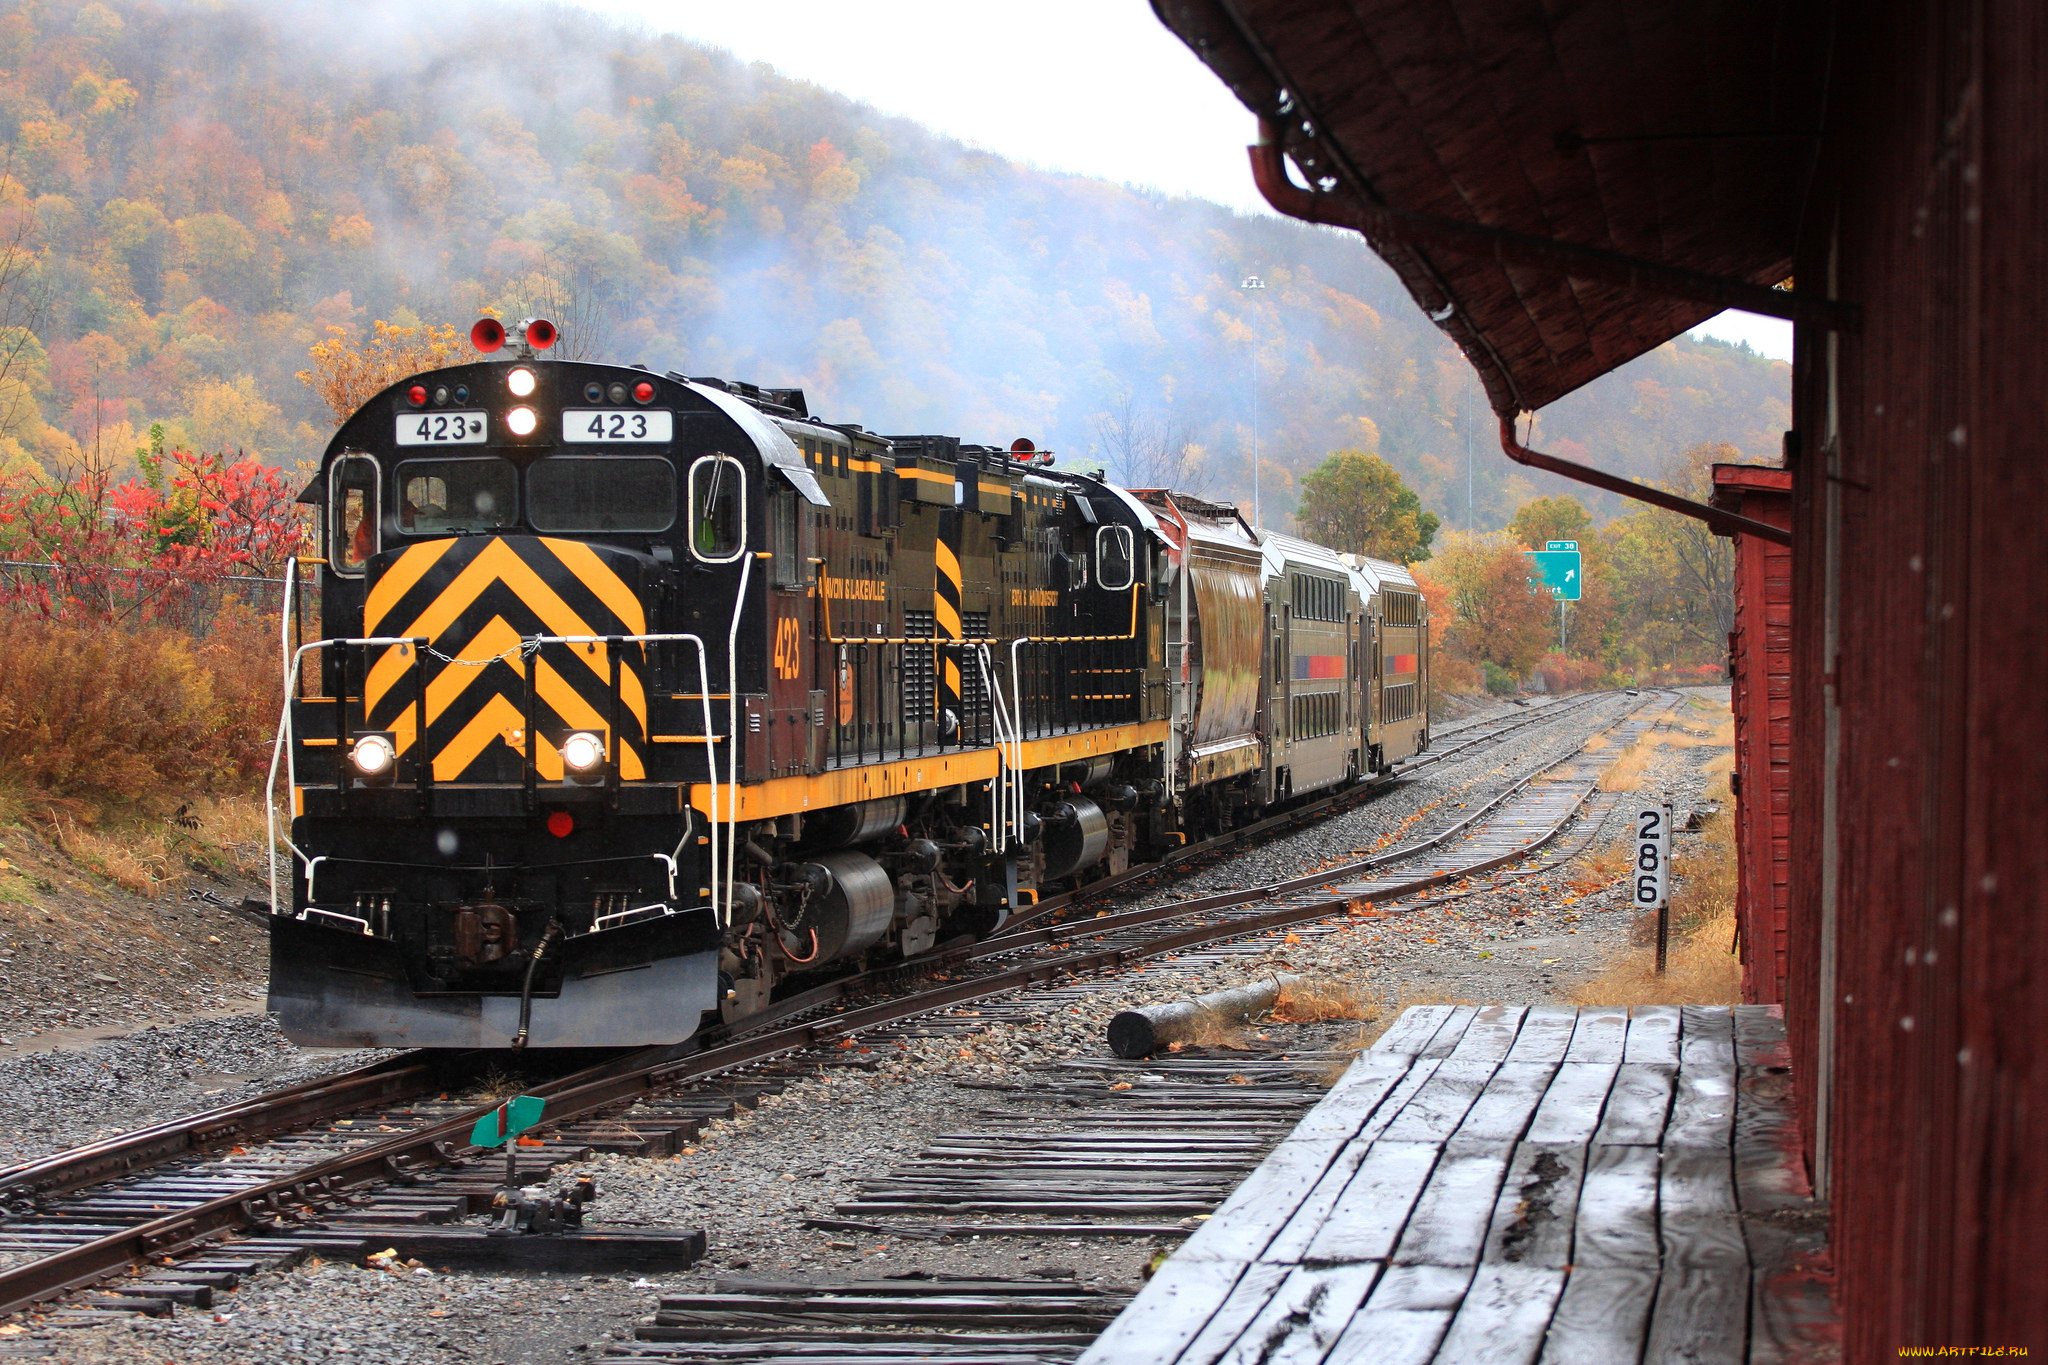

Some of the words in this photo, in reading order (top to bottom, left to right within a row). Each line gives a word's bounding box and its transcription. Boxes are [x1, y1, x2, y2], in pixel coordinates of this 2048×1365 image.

[416, 416, 467, 441] 423
[587, 414, 648, 439] 423
[850, 579, 885, 601] LAKEVILLE
[774, 617, 799, 680] 423
[1637, 811, 1660, 903] 286
